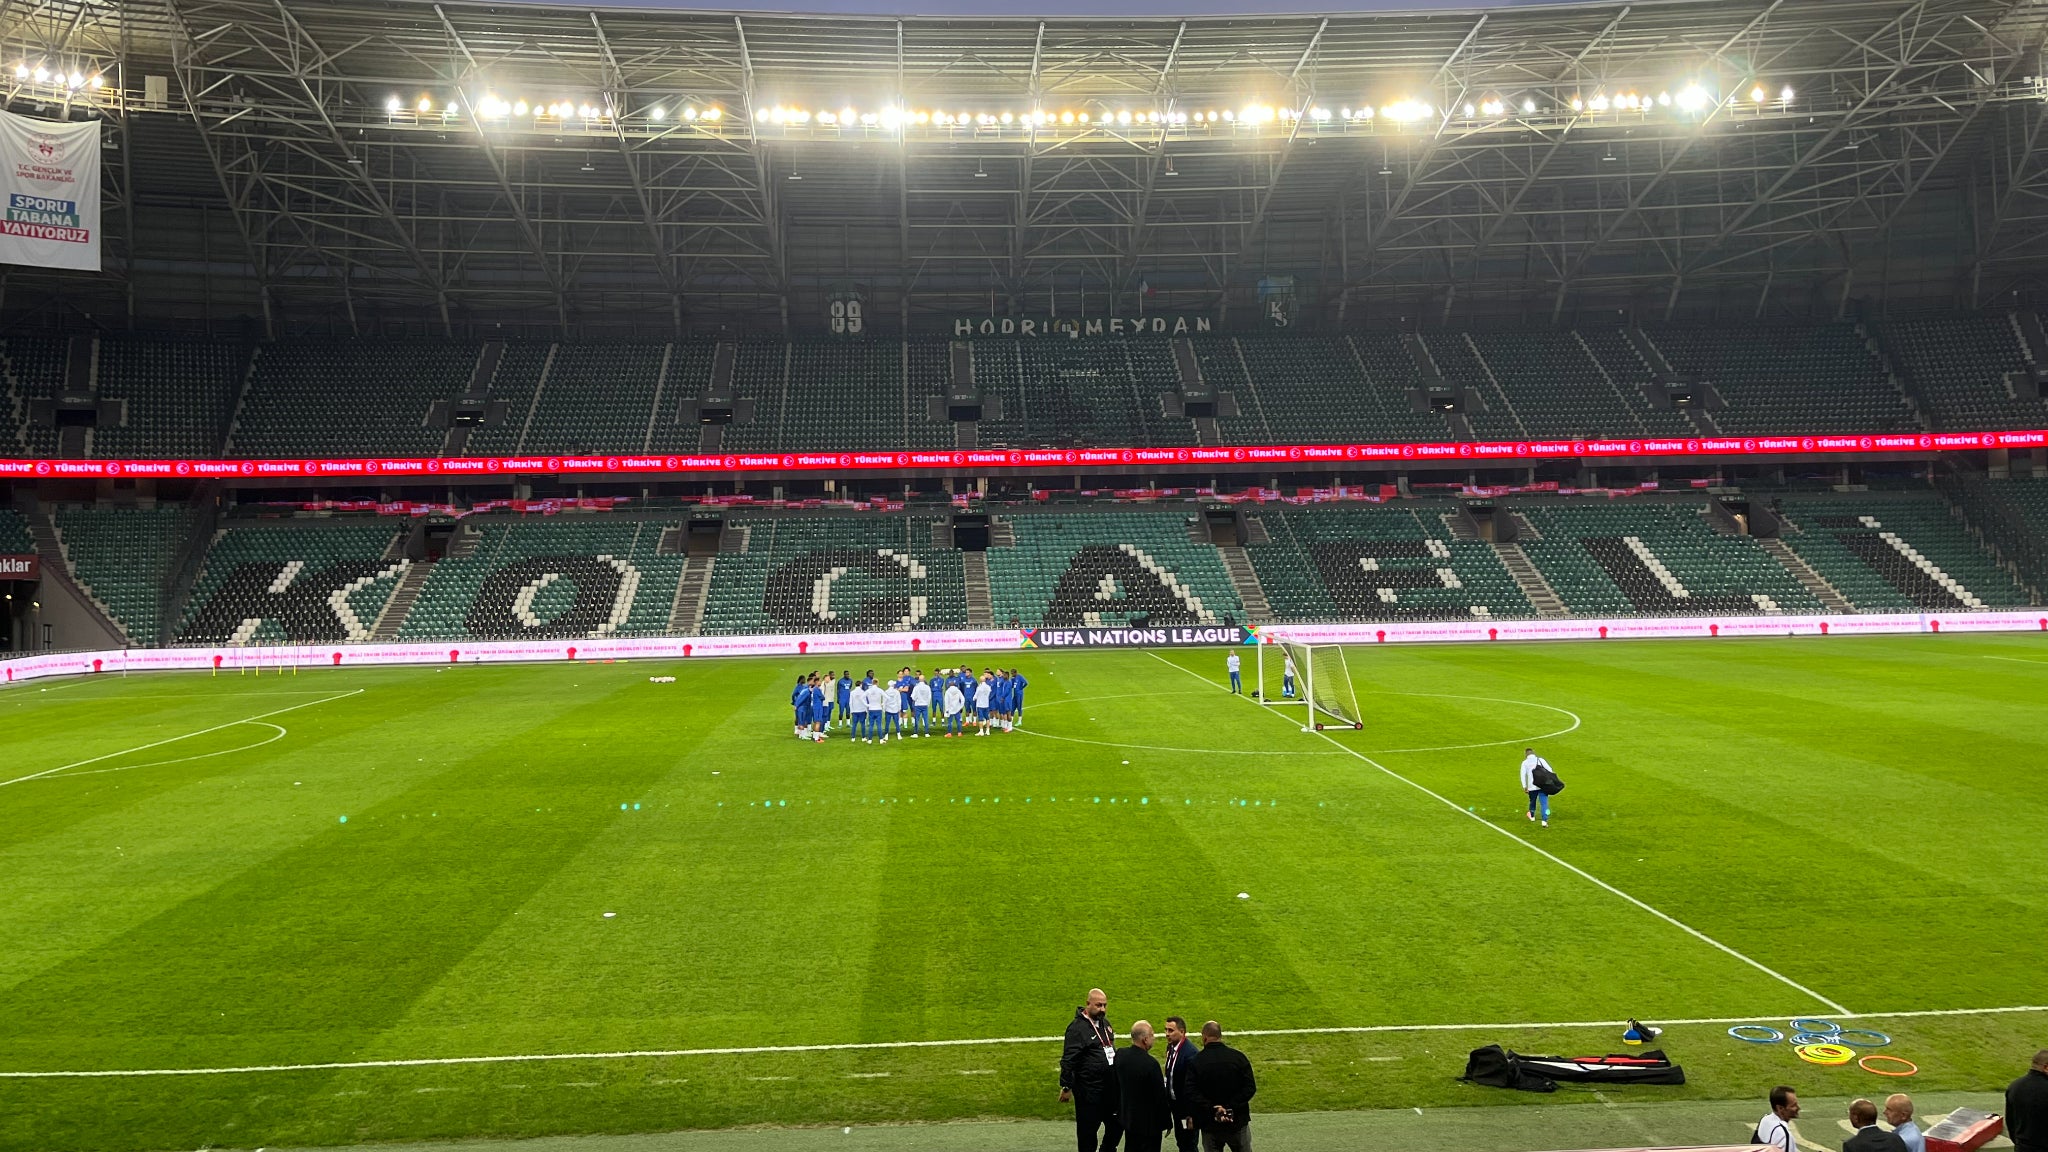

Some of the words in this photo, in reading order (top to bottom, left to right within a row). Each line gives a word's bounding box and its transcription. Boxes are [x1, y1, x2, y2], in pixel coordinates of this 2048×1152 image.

[15, 196, 67, 213] SPORU
[11, 209, 73, 227] TABANA
[2, 221, 87, 242] YAYIYORUZ
[831, 300, 862, 333] 89
[54, 463, 102, 472] TÜRKİYE
[124, 464, 170, 472] TÜRKİYE
[194, 464, 237, 472] TÜRKİYE
[258, 463, 299, 471] TÜRKİYE
[381, 462, 422, 470] TÜRKİYE
[443, 461, 483, 469] TÜRKİYE
[503, 460, 542, 468] TÜRKİYE
[622, 459, 661, 467] TÜRKİYE
[682, 458, 721, 466] TÜRKİYE
[740, 457, 778, 465] TÜRKİYE
[798, 456, 836, 464] TÜRKİYE
[1024, 453, 1063, 461] TÜRKİYE
[1080, 452, 1117, 460] TÜRKİYE
[1136, 451, 1174, 459] TÜRKİYE
[1192, 450, 1229, 458] TÜRKİYE
[1248, 449, 1286, 457] TÜRKİYE
[1304, 448, 1342, 456] TÜRKİYE
[1361, 447, 1399, 455] TÜRKİYE
[1417, 446, 1455, 454] TÜRKİYE
[1475, 445, 1513, 453] TÜRKİYE
[1531, 444, 1569, 452] TÜRKİYE
[1588, 443, 1626, 451] TÜRKİYE
[1644, 442, 1682, 450] TÜRKİYE
[1702, 441, 1740, 449] TÜRKİYE
[1759, 440, 1797, 448] TÜRKİYE
[1817, 439, 1856, 447] TÜRKİYE
[1875, 438, 1915, 446] TÜRKİYE
[1934, 436, 1978, 445] TÜRKİYE
[1999, 434, 2043, 443] TÜRKİYE
[0, 558, 31, 573] klar
[1040, 630, 1084, 646] UEFA
[1088, 628, 1167, 645] NATIONS
[1171, 627, 1241, 643] LEAGUE
